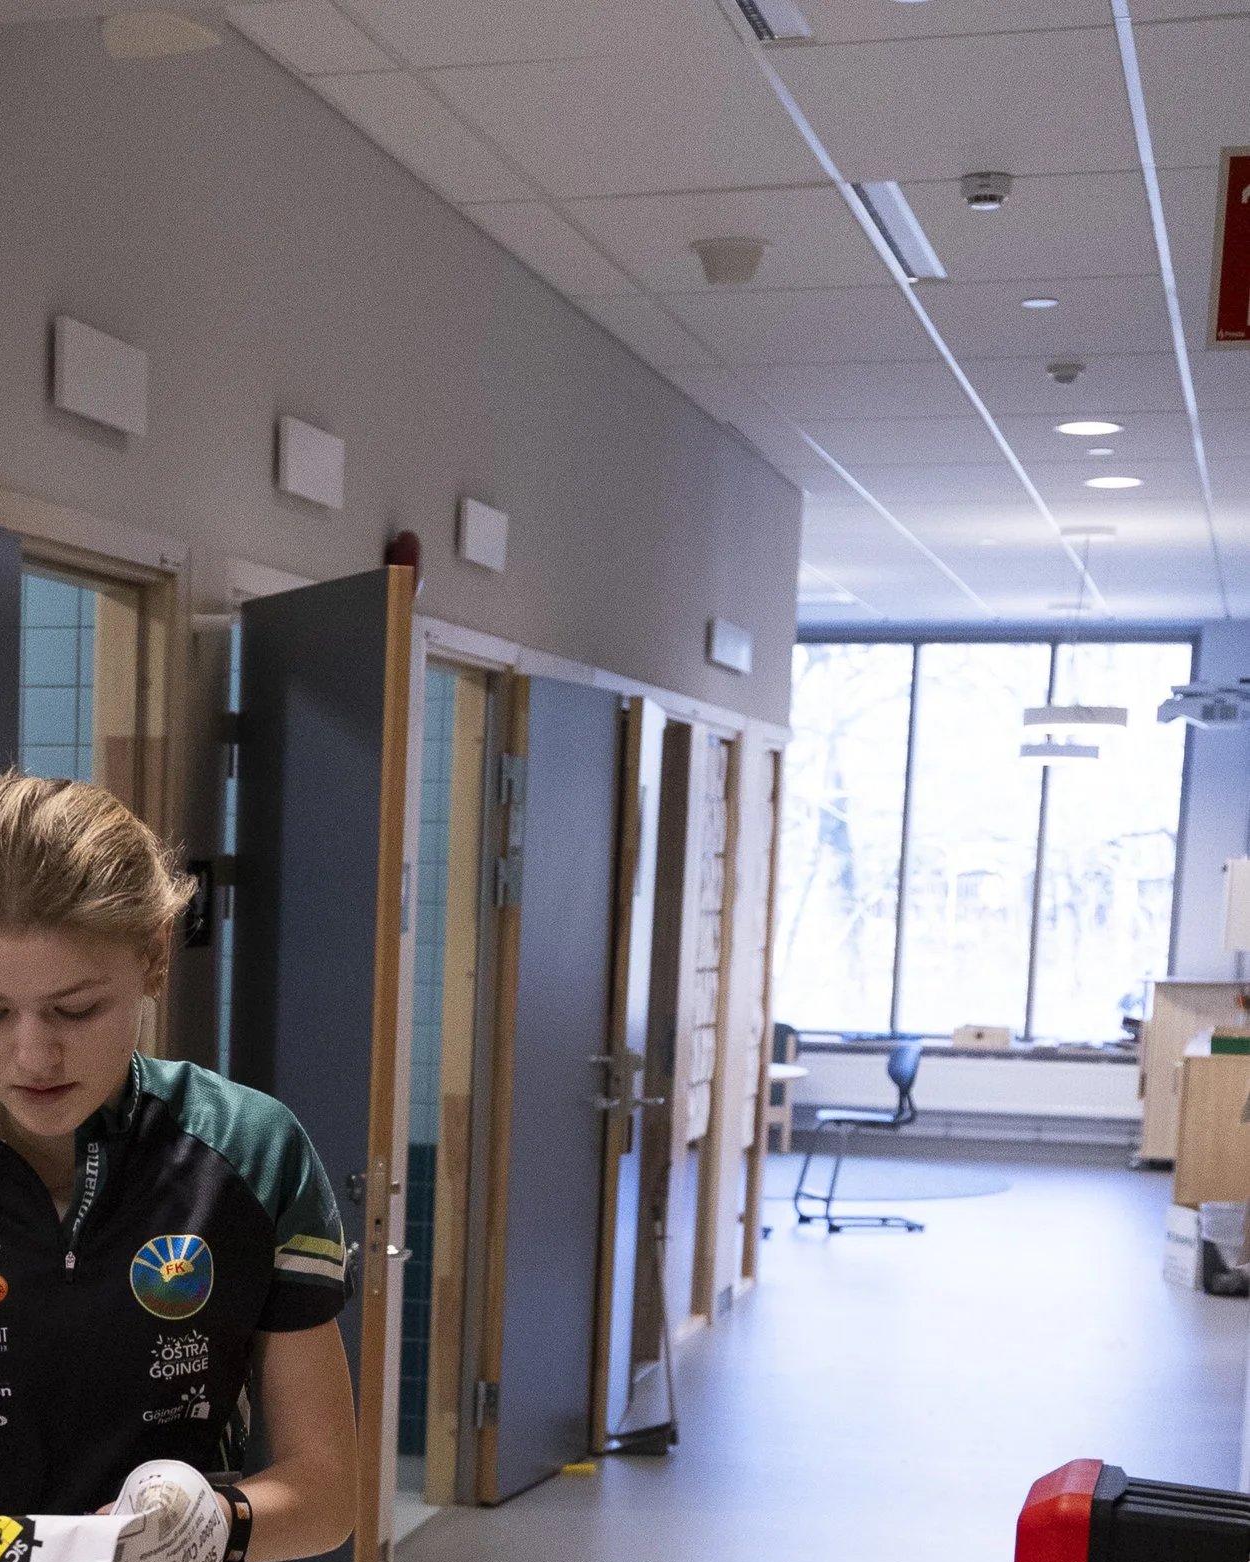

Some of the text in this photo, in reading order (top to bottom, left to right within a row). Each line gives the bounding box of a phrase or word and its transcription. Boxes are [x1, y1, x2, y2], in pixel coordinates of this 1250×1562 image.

[165, 1261, 185, 1275] FK
[161, 1342, 209, 1360] ÖSTRA
[142, 1405, 184, 1422] Göinge
[199, 1510, 221, 1548] Indoor
